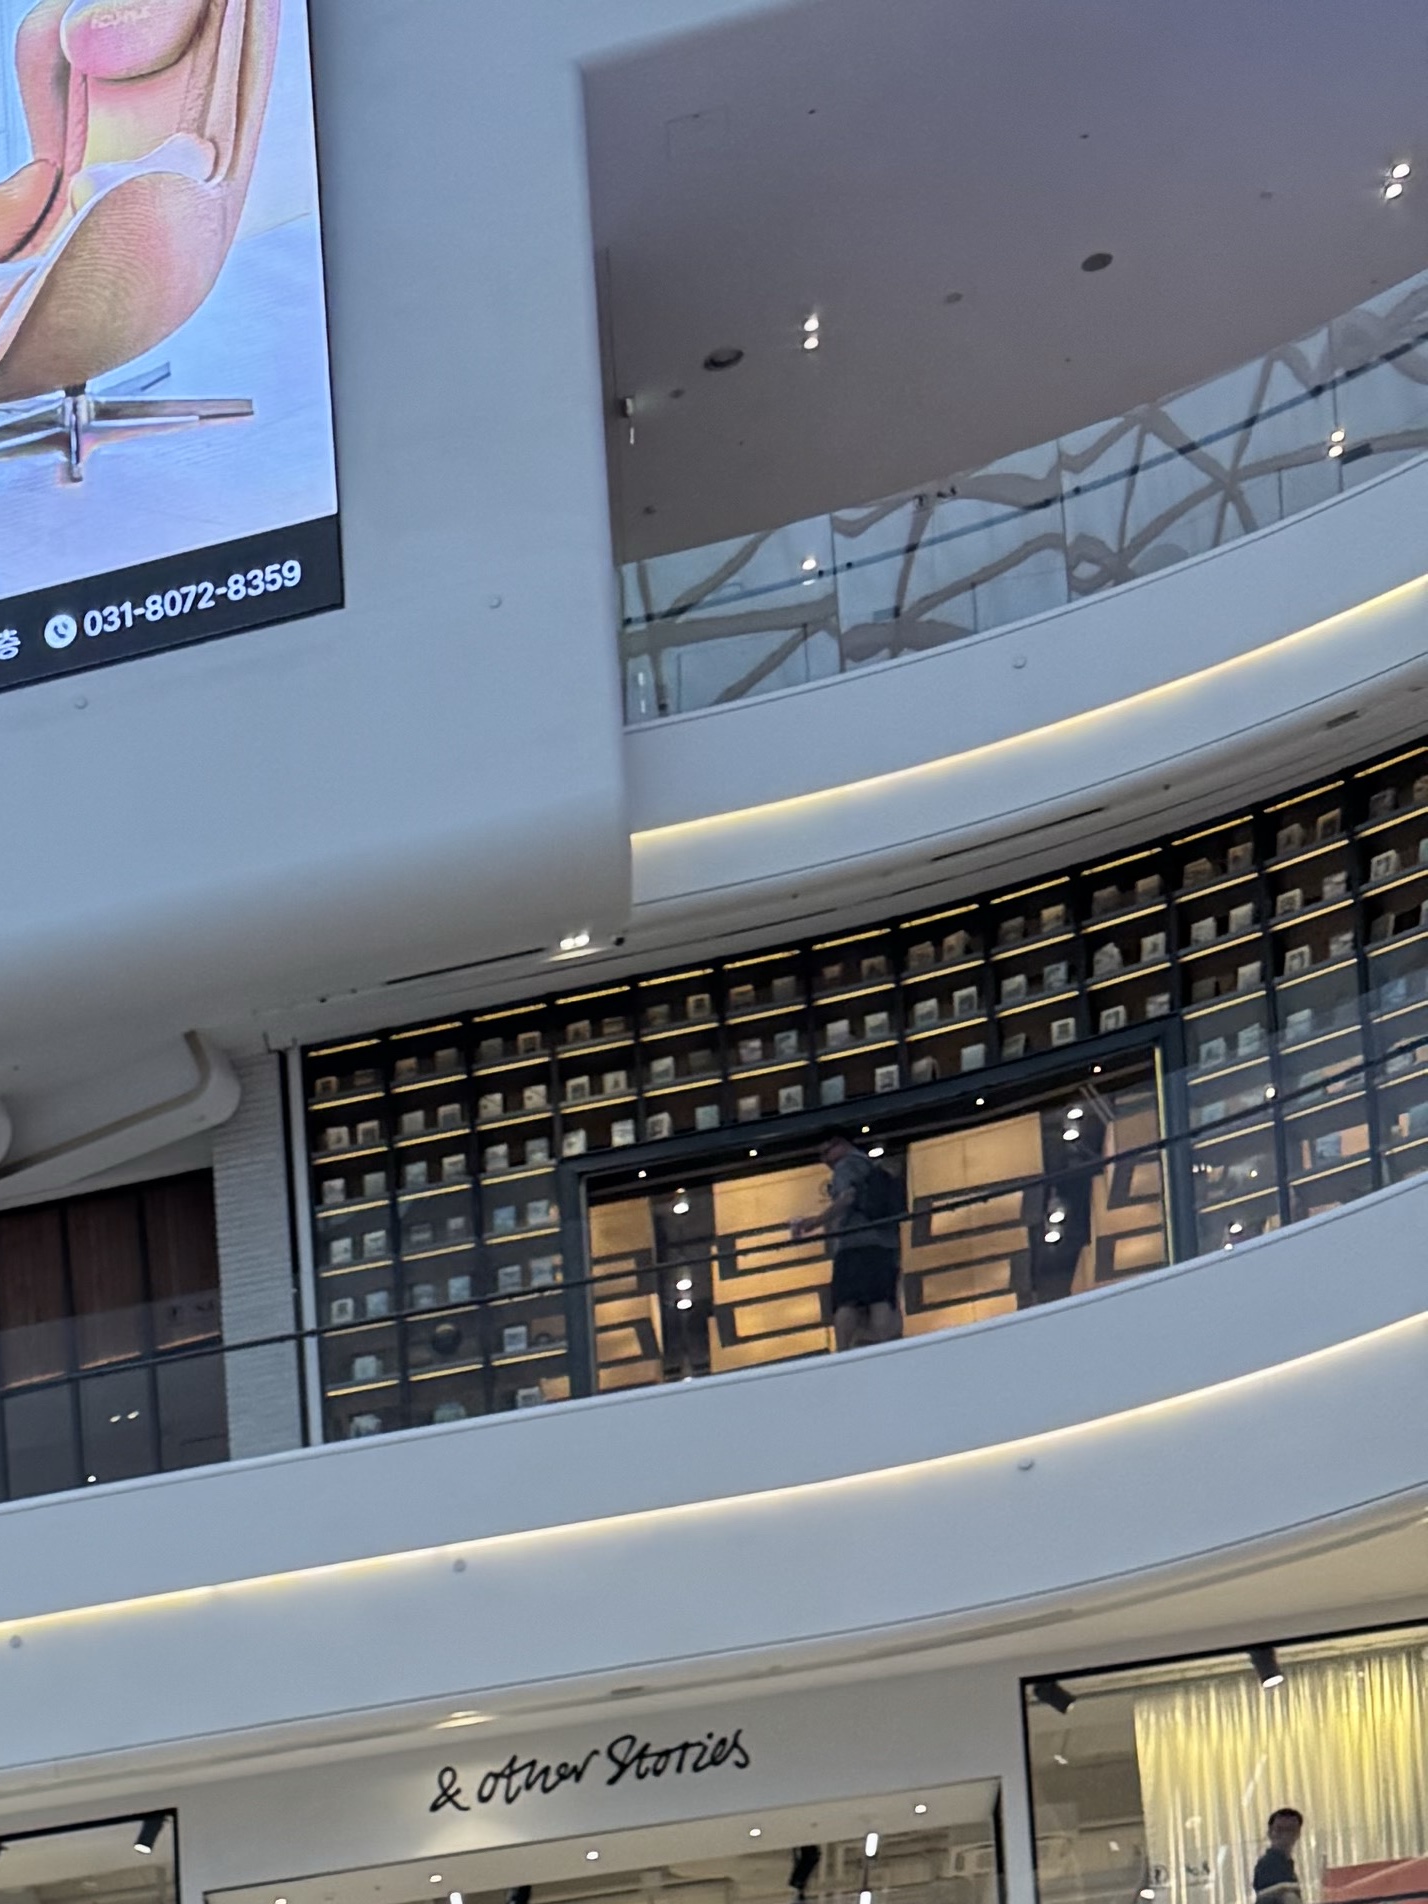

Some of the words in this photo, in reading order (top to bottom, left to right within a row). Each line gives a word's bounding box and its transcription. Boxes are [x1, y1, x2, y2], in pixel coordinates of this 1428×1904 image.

[83, 558, 303, 640] 031-8072-8359
[429, 1766, 471, 1813] &
[477, 1749, 600, 1805] other
[606, 1728, 751, 1787] Stories
